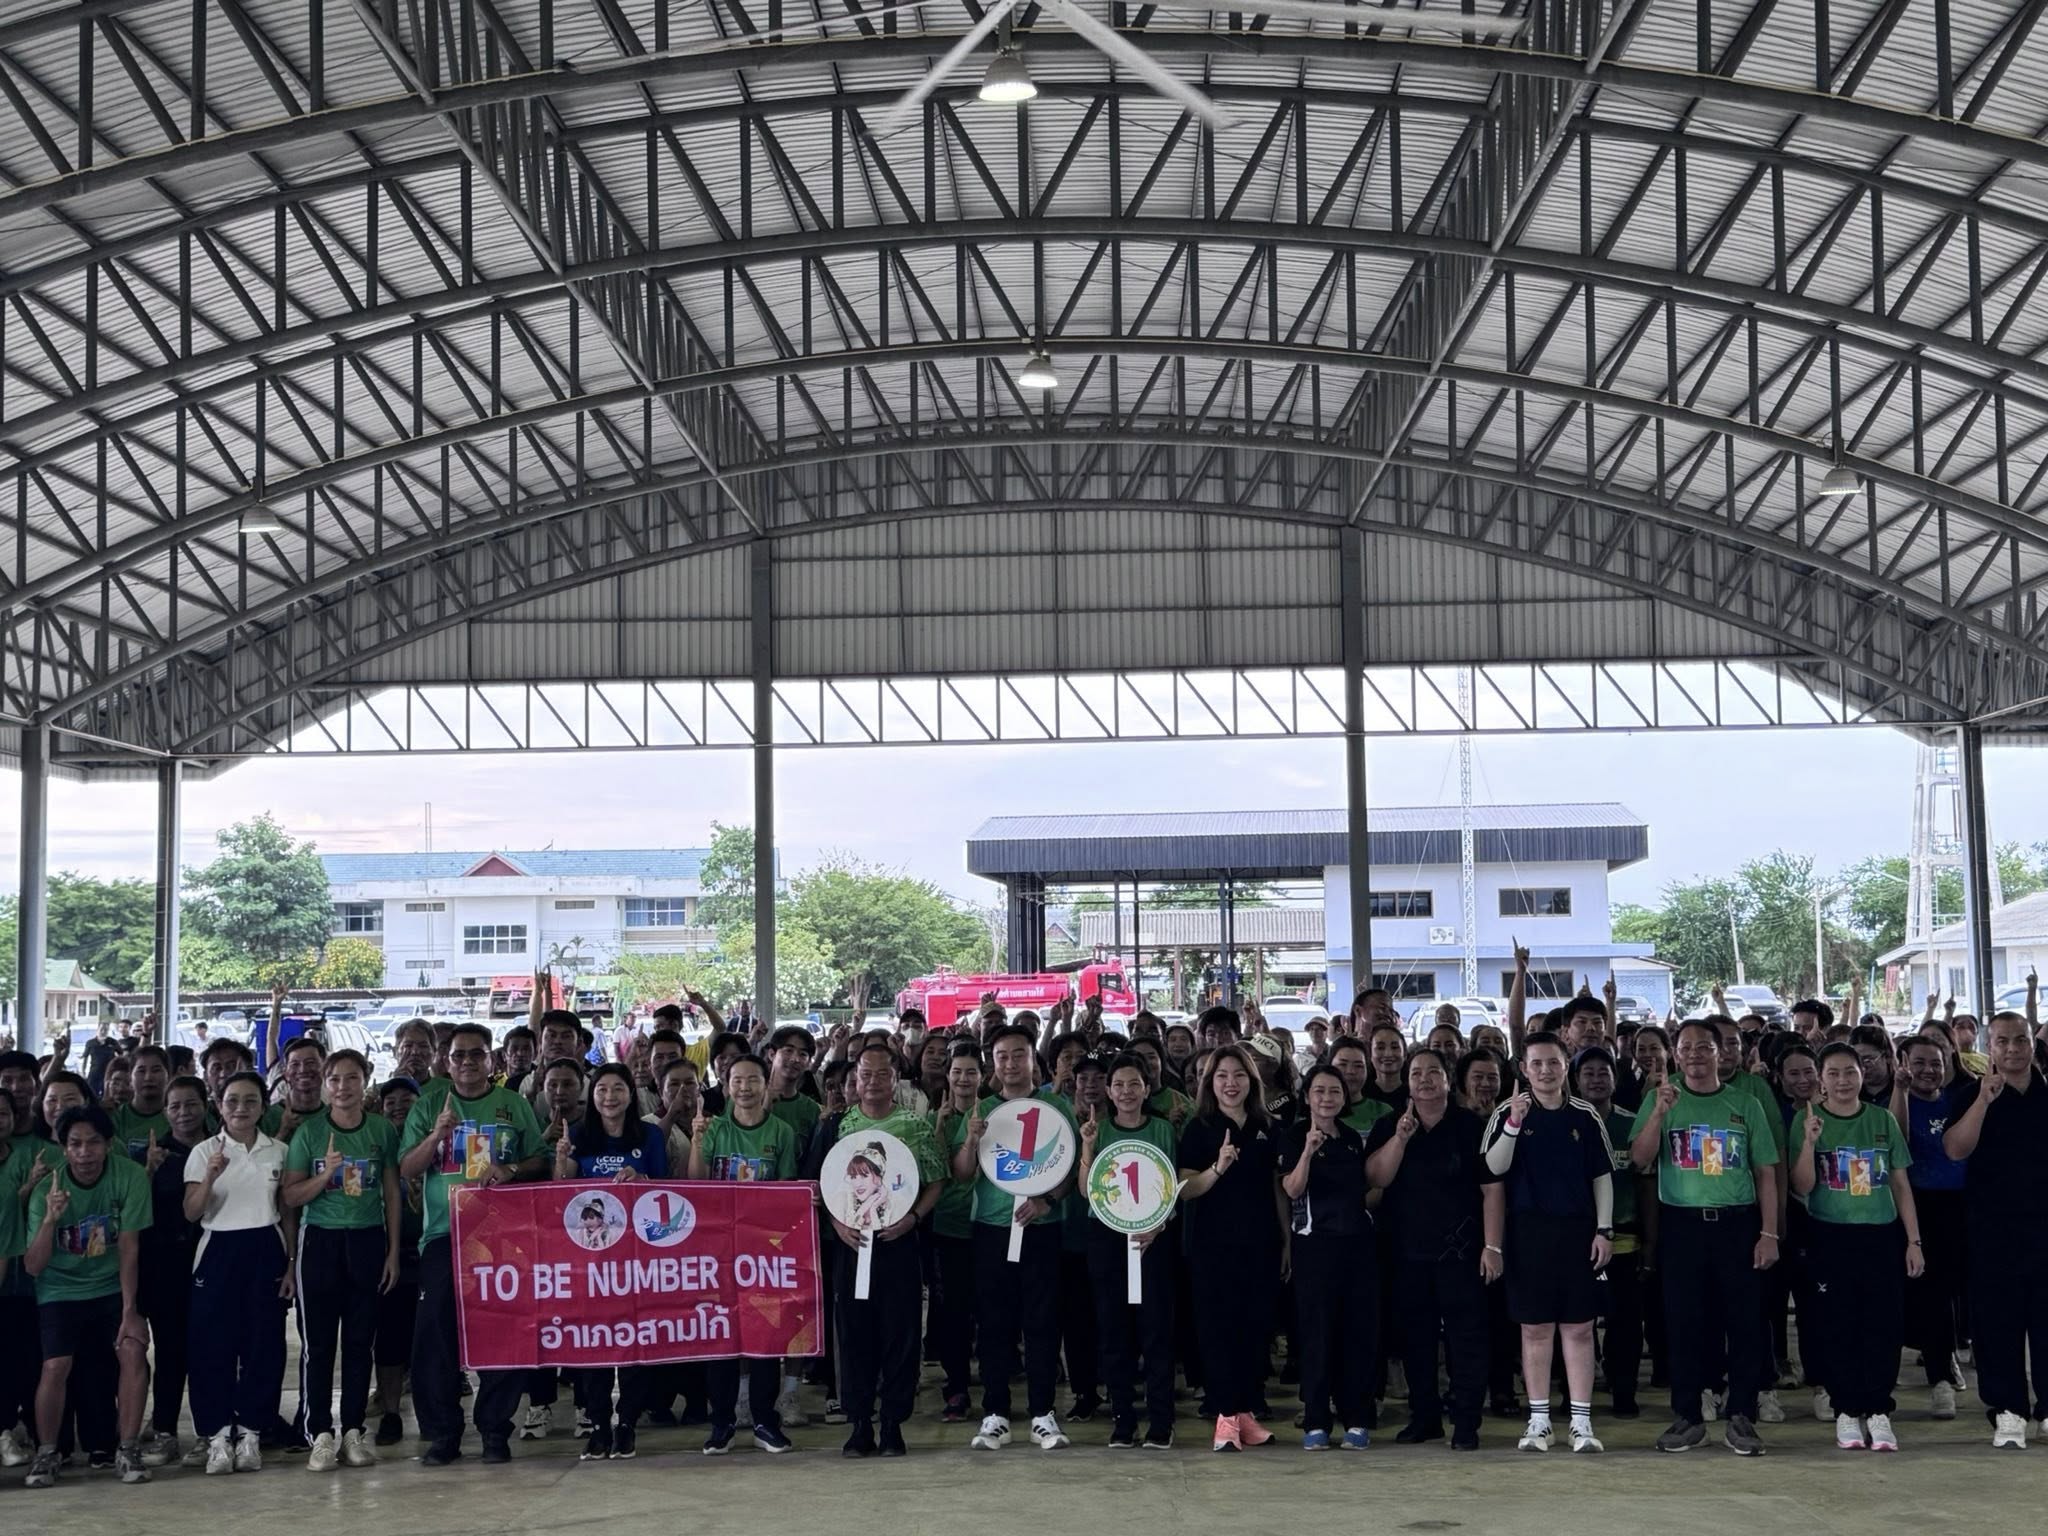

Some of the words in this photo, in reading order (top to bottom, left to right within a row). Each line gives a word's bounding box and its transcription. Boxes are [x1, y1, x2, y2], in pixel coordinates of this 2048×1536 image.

[1016, 1107, 1040, 1161] 1
[1003, 1160, 1025, 1175] BE
[1121, 1161, 1139, 1204] 1
[653, 1193, 670, 1227] 1
[473, 1264, 520, 1301] TO
[533, 1262, 572, 1299] BE
[588, 1256, 719, 1297] NUMBER
[734, 1254, 797, 1289] ONE
[540, 1302, 731, 1350] อำเภอสามโก้
